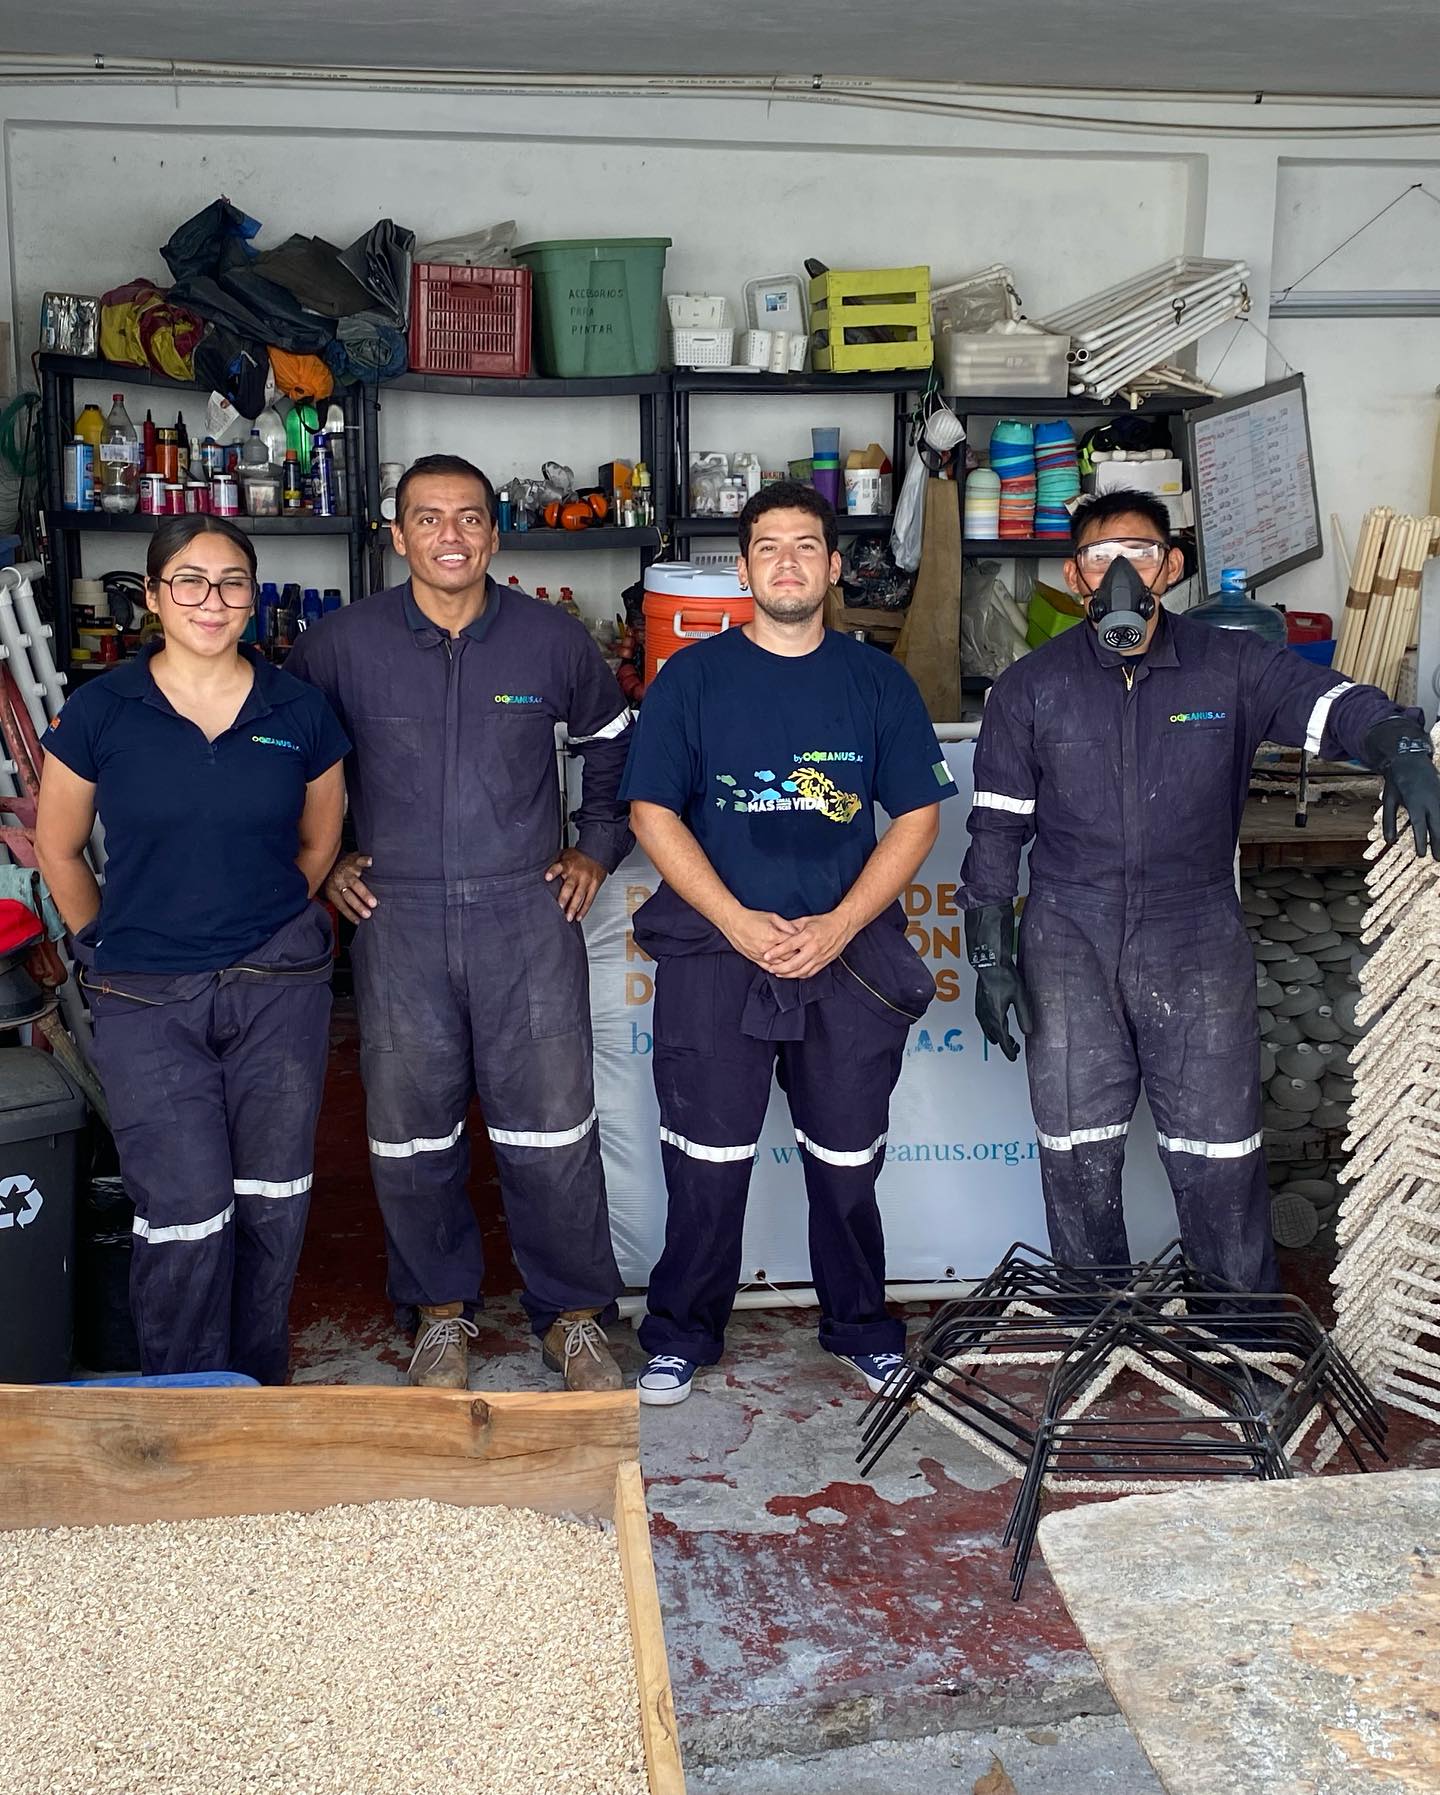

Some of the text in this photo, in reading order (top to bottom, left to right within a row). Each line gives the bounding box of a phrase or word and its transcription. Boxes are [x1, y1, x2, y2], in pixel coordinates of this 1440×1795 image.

[570, 306, 594, 317] PARA
[571, 324, 613, 336] PINTAR
[905, 883, 959, 917] DE
